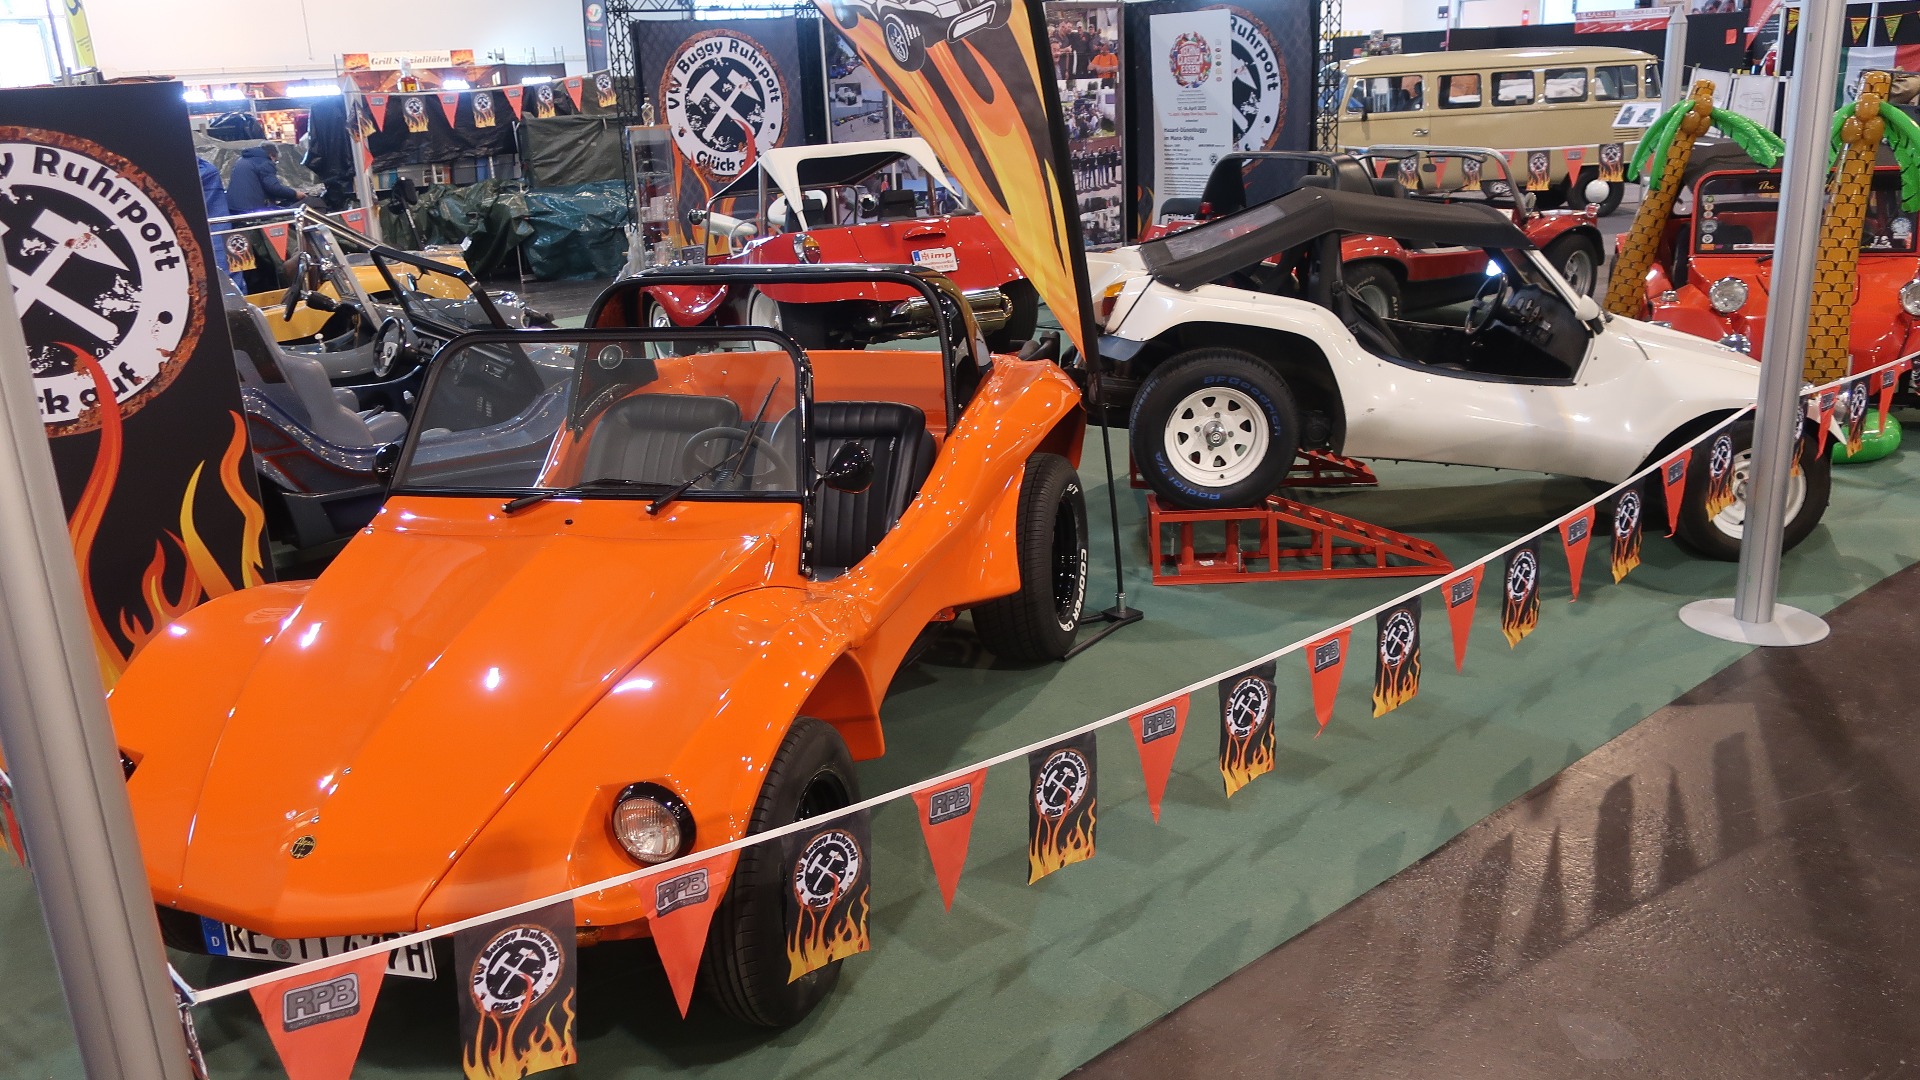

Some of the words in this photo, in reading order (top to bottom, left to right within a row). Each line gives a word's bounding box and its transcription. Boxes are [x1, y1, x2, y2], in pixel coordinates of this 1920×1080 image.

[371, 57, 393, 65] Grill
[394, 55, 450, 64] Szialitäten
[677, 40, 723, 74] Buggy
[729, 39, 780, 103] Ruhrpott
[1758, 180, 1775, 190] The
[33, 146, 181, 273] Ruhrpott
[1203, 375, 1281, 437] BFGoodrich
[1071, 548, 1087, 622] COOPER
[1315, 641, 1339, 666] RPB
[1143, 708, 1175, 737] RPB
[932, 787, 970, 817] RPB
[658, 872, 707, 909] RPB
[211, 936, 220, 947] D
[224, 923, 269, 954] RE
[521, 929, 559, 961] Ruhrpott
[286, 977, 357, 1020] RPB
